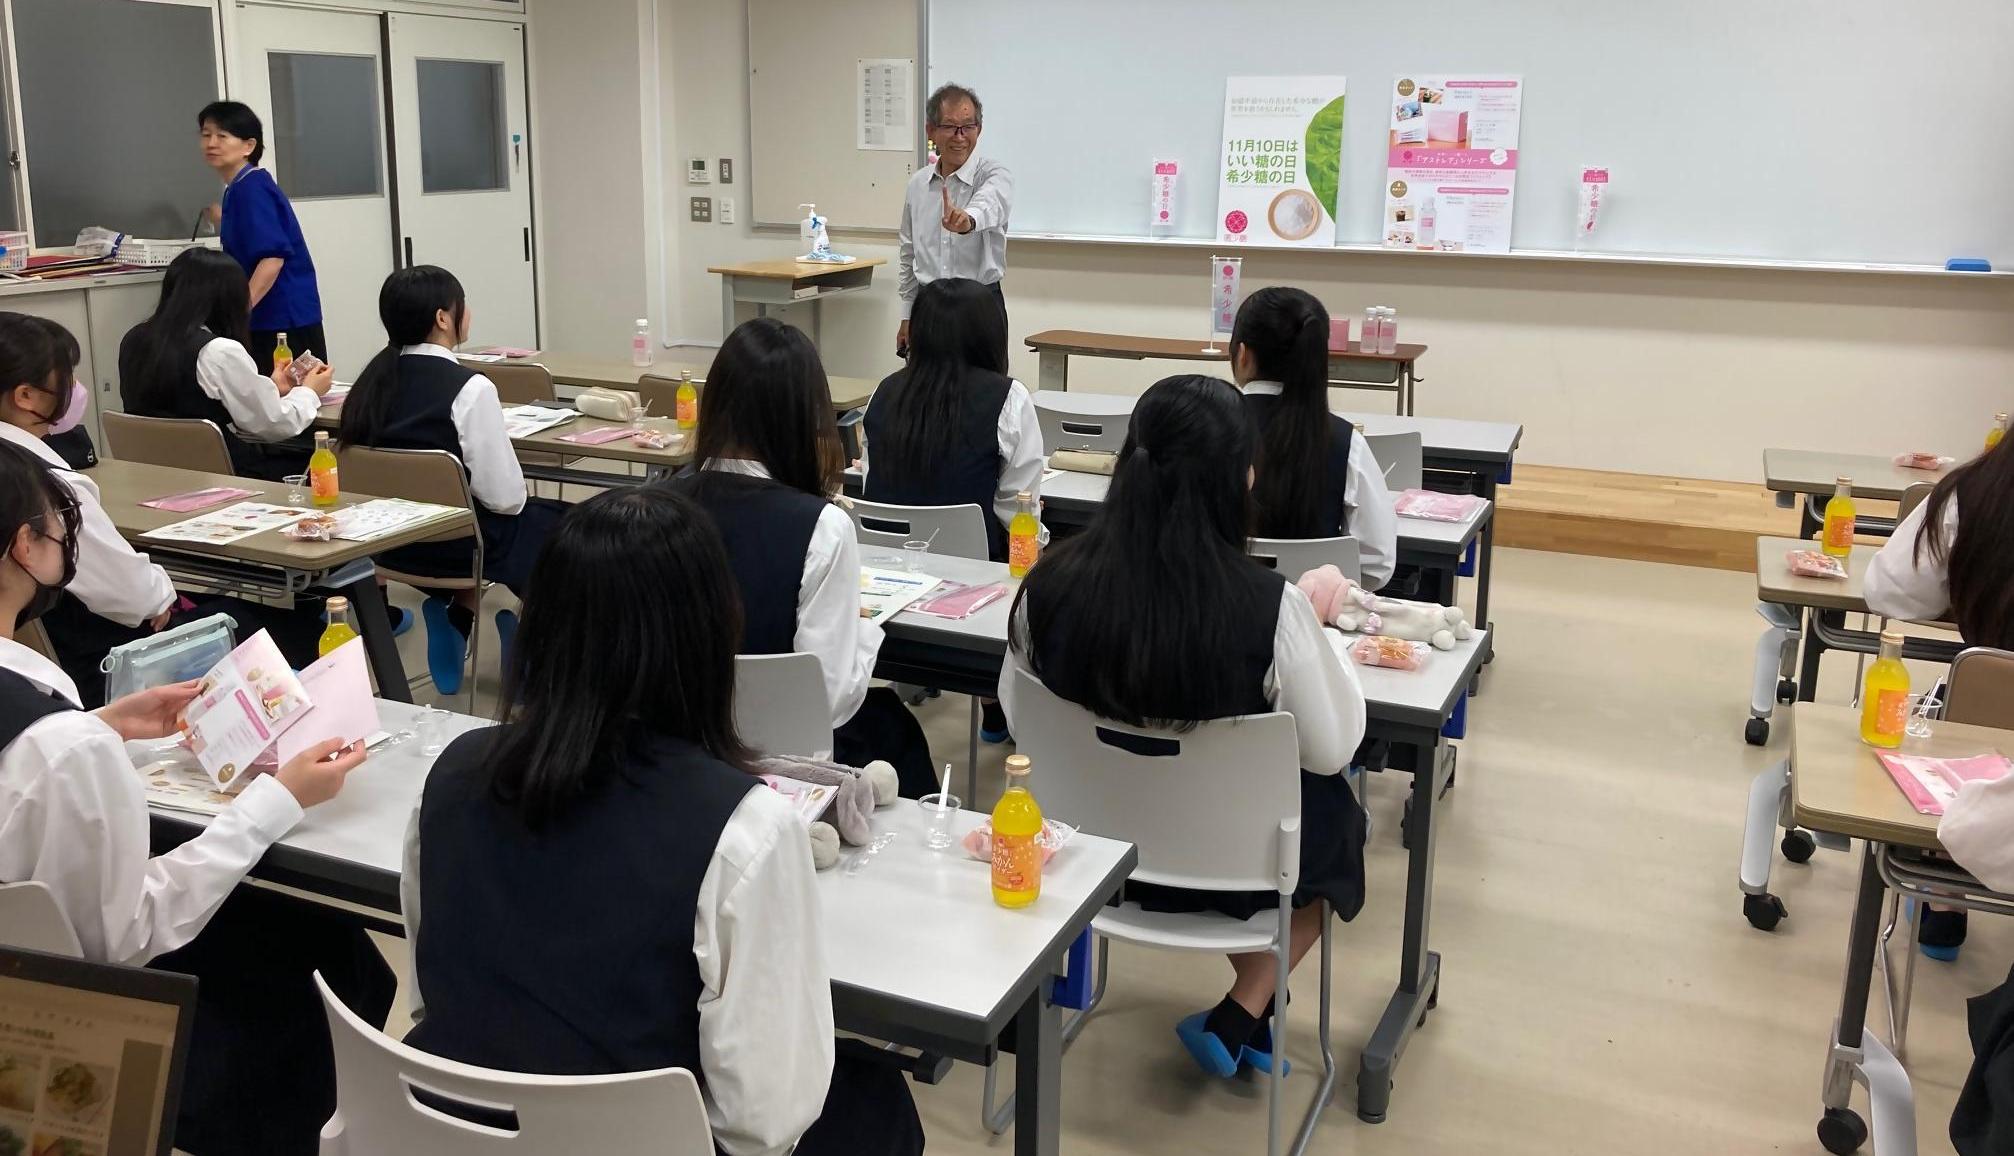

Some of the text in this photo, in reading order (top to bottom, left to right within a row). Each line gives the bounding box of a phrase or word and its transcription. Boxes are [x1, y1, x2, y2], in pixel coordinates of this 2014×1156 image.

[1228, 139, 1299, 153] 11月10日は
[1227, 154, 1297, 169] いい糖の日
[1226, 169, 1296, 184] 希少糖の日
[1222, 285, 1233, 324] 希少糖
